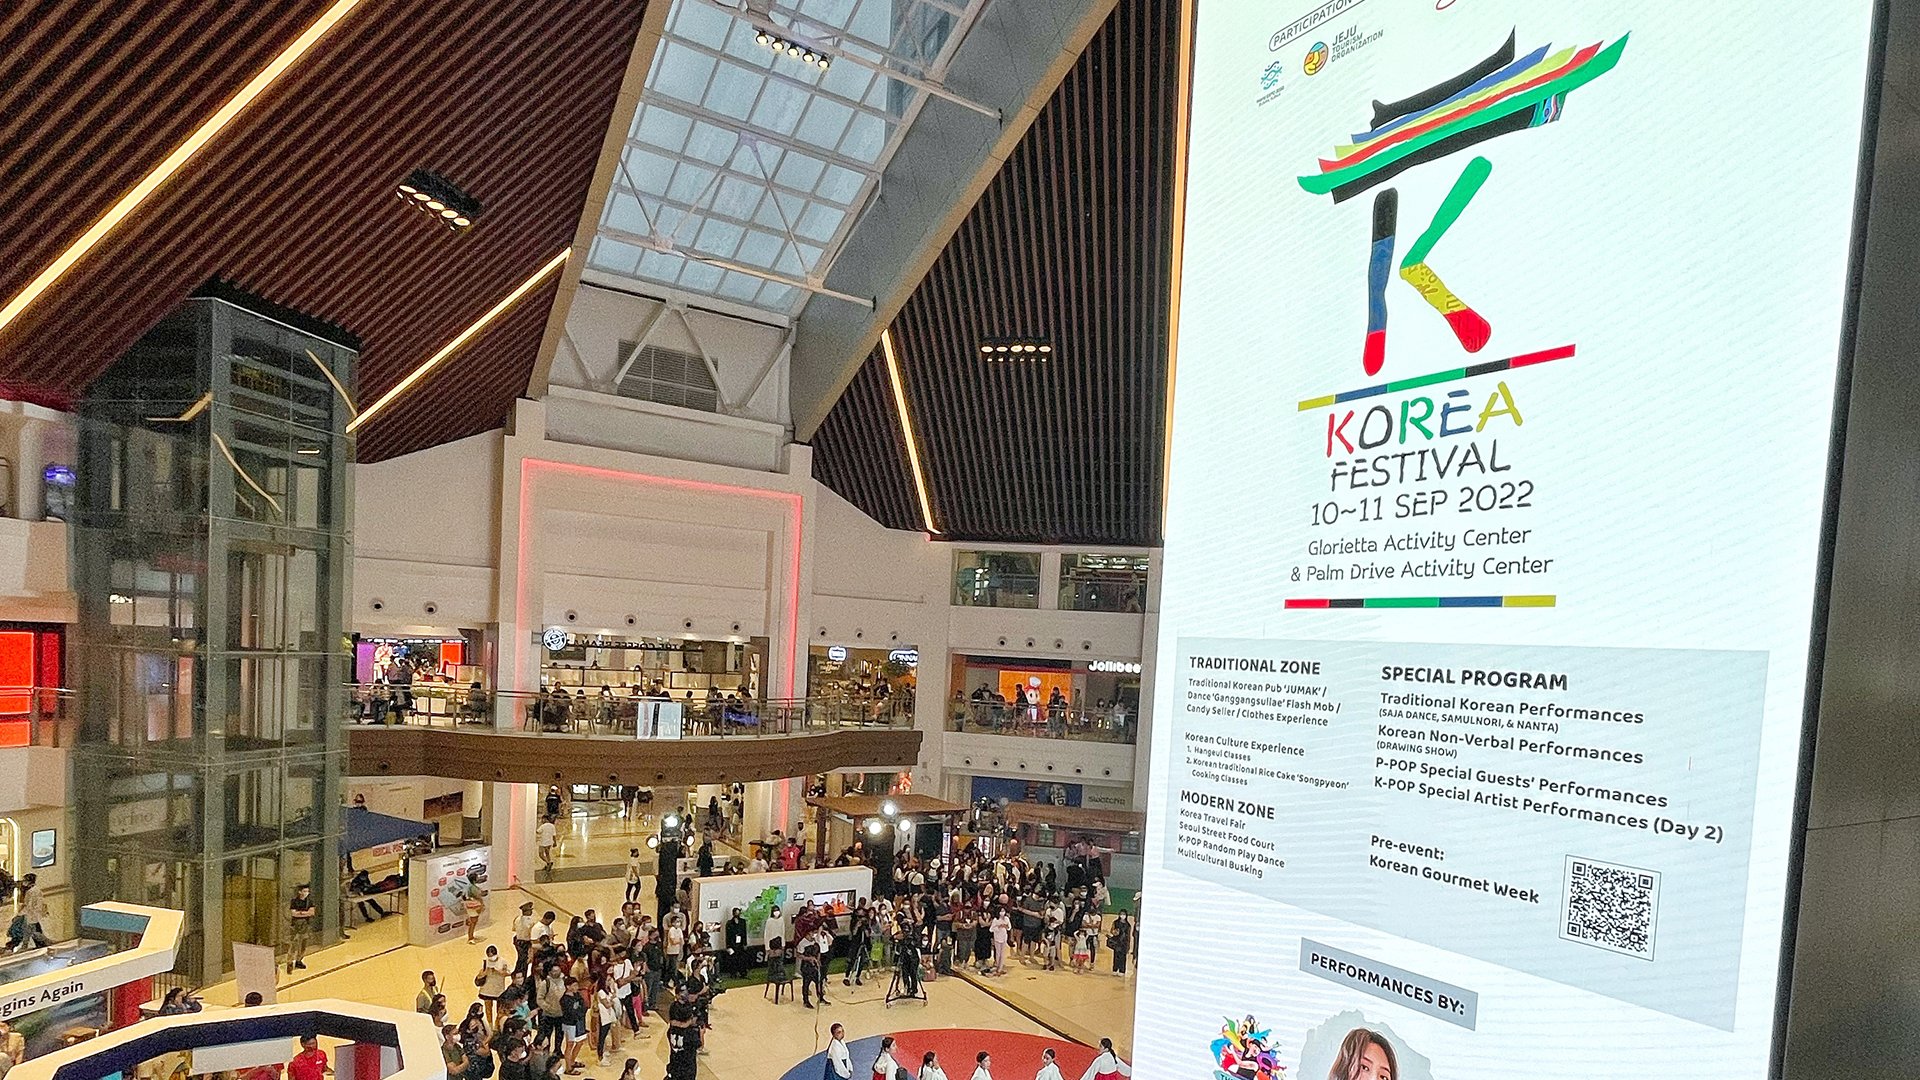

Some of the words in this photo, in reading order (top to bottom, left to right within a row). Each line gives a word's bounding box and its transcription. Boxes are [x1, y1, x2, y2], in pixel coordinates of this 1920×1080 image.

[1332, 32, 1362, 53] TOURISM
[1332, 29, 1383, 62] ORGANIZATION
[1333, 25, 1356, 46] JEJU
[1327, 381, 1523, 457] KOREA
[1331, 439, 1511, 491] FESTIVAL
[1312, 496, 1383, 526] 10~11
[1395, 490, 1448, 518] SEP
[1459, 480, 1534, 513] 2022
[1308, 537, 1377, 555] Glorietta
[1384, 531, 1456, 551] Activity
[1463, 527, 1531, 546] Center
[1291, 566, 1300, 582] &
[1307, 564, 1344, 581] Palm
[1351, 562, 1395, 580] Drive
[1401, 558, 1475, 579] Activity
[1483, 555, 1553, 575] Center
[1088, 661, 1141, 674] Jollibee
[1189, 657, 1276, 673] TRADITIONAL
[1280, 661, 1321, 675] ZONE
[1382, 666, 1455, 684] SPECIAL
[1461, 670, 1568, 691] PROGRAM
[1189, 678, 1231, 689] Traditional
[1233, 682, 1263, 691] Korean
[1265, 683, 1282, 692] Pub
[1188, 691, 1211, 701] Dance
[1287, 700, 1310, 710] Flash
[1313, 702, 1334, 711] Mob
[1381, 693, 1456, 709] Traditional
[1460, 698, 1515, 713] Korean
[1519, 702, 1643, 724] Performances
[1187, 704, 1210, 715] Candy
[1212, 707, 1235, 717] Seller
[1242, 710, 1274, 720] Clothes
[1277, 713, 1328, 726] Experience
[1379, 708, 1403, 719] (SAJA
[1406, 710, 1439, 723] DANCE,
[1441, 713, 1503, 728] SAMULNORI,
[1506, 719, 1514, 729] &
[1517, 720, 1558, 734] NANTA)
[1185, 732, 1214, 744] Korean
[1216, 736, 1248, 749] Culture
[1251, 741, 1305, 756] Experience
[1194, 747, 1222, 757] Hangeul
[1224, 750, 1250, 761] Classes
[1376, 740, 1423, 754] (DRAWING
[1425, 745, 1457, 758] SHOW)
[1378, 725, 1425, 741] Korean
[1430, 729, 1514, 751] Non-Verbal
[1519, 738, 1643, 764] Performances
[1192, 769, 1219, 782] Cooking
[1221, 774, 1248, 786] Classes
[1193, 758, 1217, 768] Korean
[1219, 761, 1257, 774] traditional
[1259, 768, 1275, 777] Rice
[1277, 771, 1295, 780] Cake
[1376, 757, 1416, 772] P-POP
[1420, 762, 1472, 782] Special
[1540, 777, 1668, 808] Performances
[1181, 790, 1234, 811] MODERN
[1238, 802, 1274, 819] ZONE
[1374, 776, 1415, 793] K-POP
[1419, 783, 1470, 802] Special
[1474, 791, 1518, 809] Artist
[1523, 798, 1649, 829] Performances
[1653, 817, 1698, 840] (Day
[1704, 824, 1723, 843] 2)
[1180, 808, 1202, 820] Korea
[1204, 813, 1228, 826] Travel
[1230, 819, 1246, 829] Fair
[1179, 822, 1200, 833] Seoul
[1202, 826, 1226, 840] Street
[1228, 832, 1248, 844] Food
[1250, 838, 1275, 850] Court
[1371, 835, 1445, 860] Pre-event:
[1178, 847, 1227, 868] Multicultural
[1229, 859, 1263, 878] Busking
[1179, 834, 1201, 847] K-POP
[1203, 840, 1236, 855] Random
[1238, 848, 1255, 862] Play
[1257, 853, 1285, 868] Dance
[1370, 855, 1418, 876] Korean
[1422, 863, 1490, 892] Gourmet
[1493, 881, 1540, 904] Week
[1311, 952, 1433, 1004] PERFORMANCES
[1438, 994, 1465, 1015] BY:
[0, 996, 36, 1016] gins
[41, 981, 83, 1002] Again
